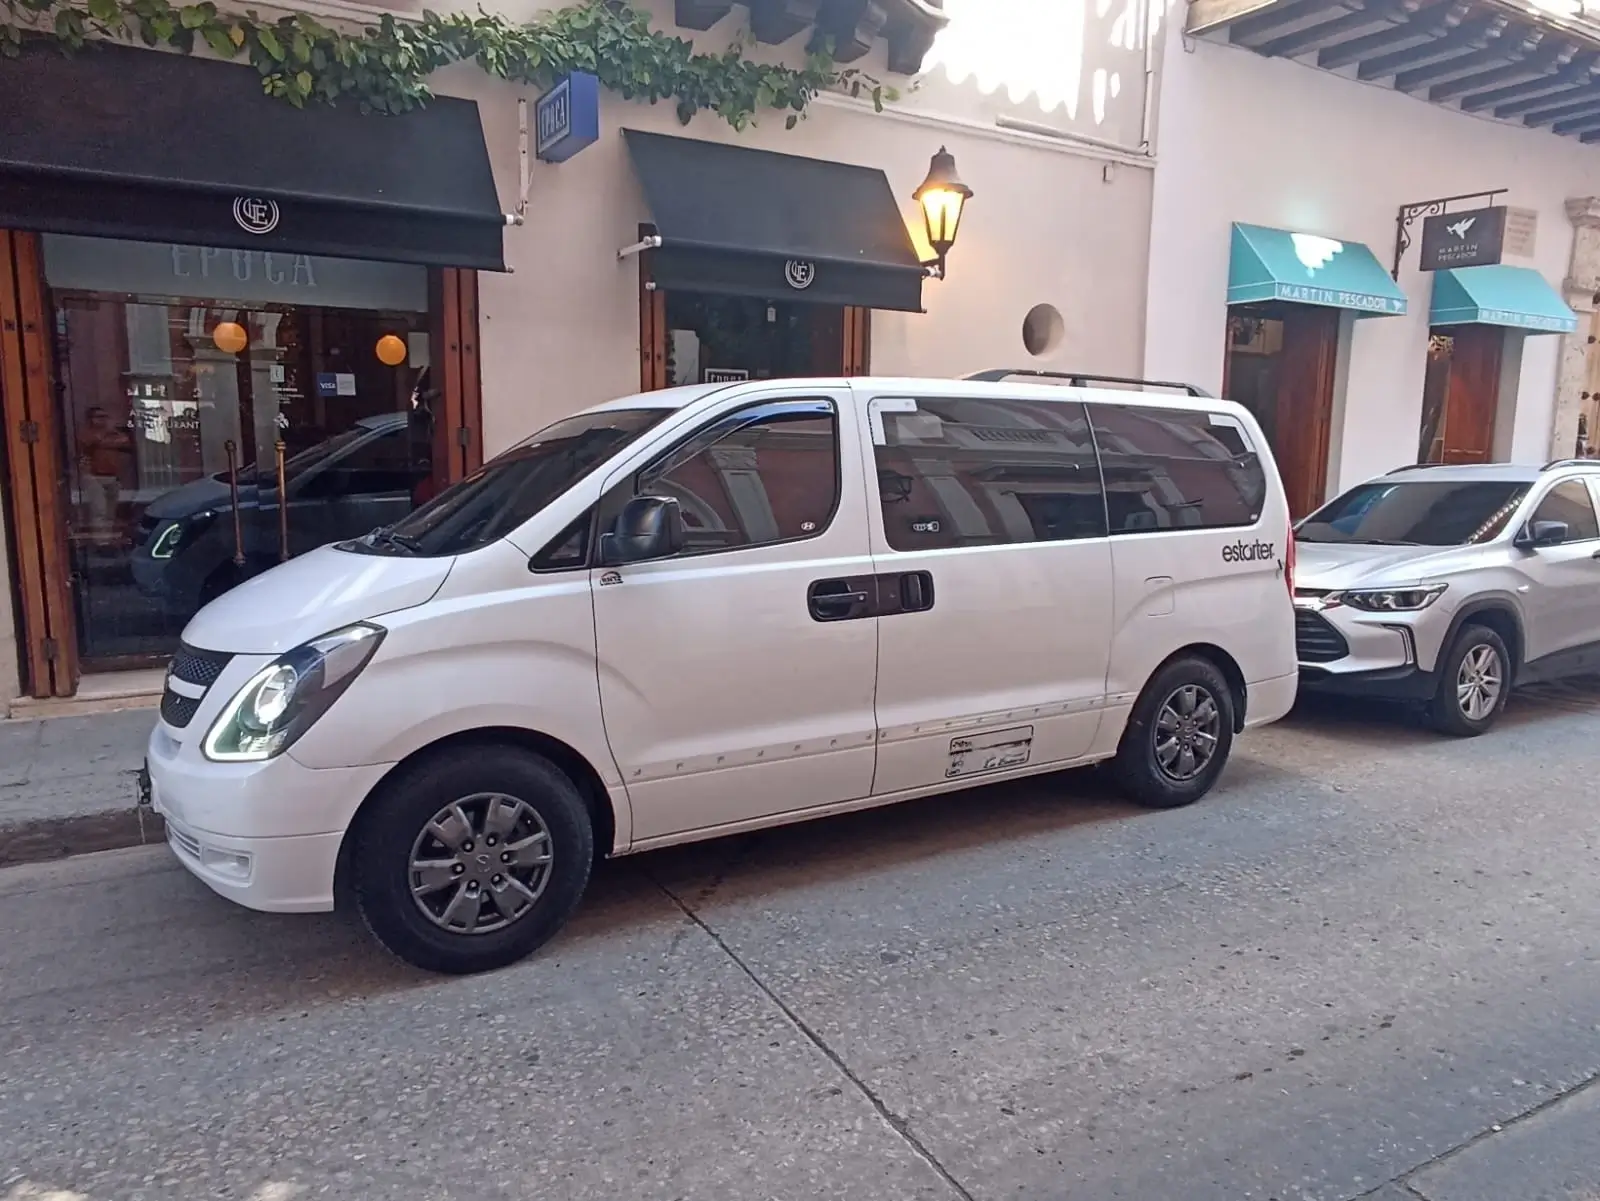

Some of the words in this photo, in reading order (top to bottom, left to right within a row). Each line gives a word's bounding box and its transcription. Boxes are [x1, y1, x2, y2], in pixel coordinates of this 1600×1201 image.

[1281, 285, 1333, 302] MARTIN
[1339, 292, 1387, 310] PESCADOR
[1222, 539, 1275, 562] estarter
